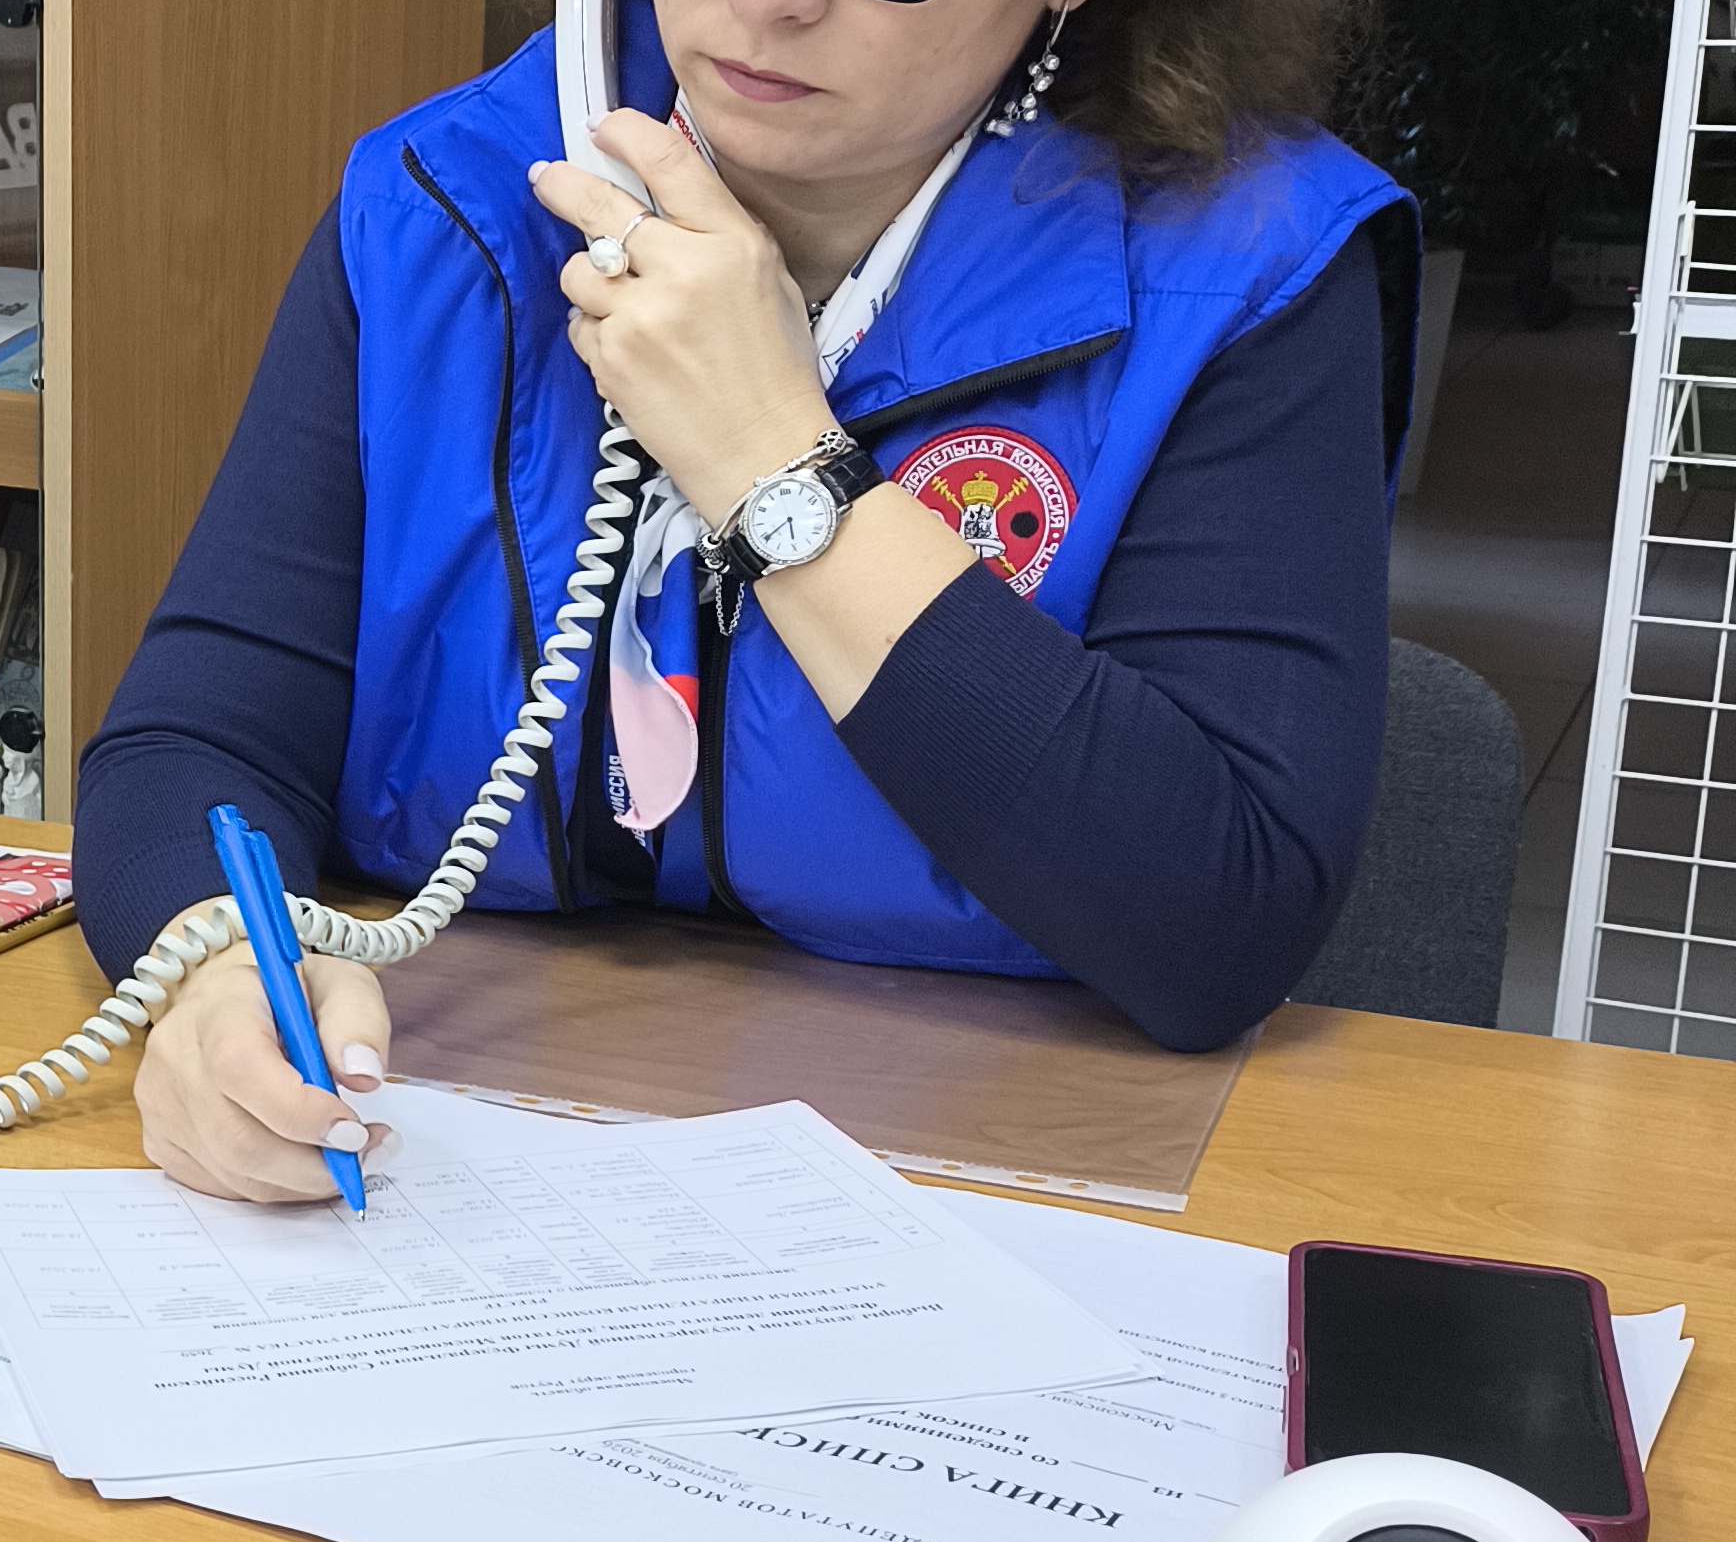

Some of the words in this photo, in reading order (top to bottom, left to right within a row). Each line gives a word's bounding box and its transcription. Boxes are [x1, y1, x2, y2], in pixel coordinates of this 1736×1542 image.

[1009, 447, 1065, 528] КОМИССИЯ
[867, 1416, 1024, 1457] сведениями
[918, 1410, 1007, 1438] список
[1030, 1454, 1060, 1466] со
[944, 1466, 1125, 1529] КНИГА
